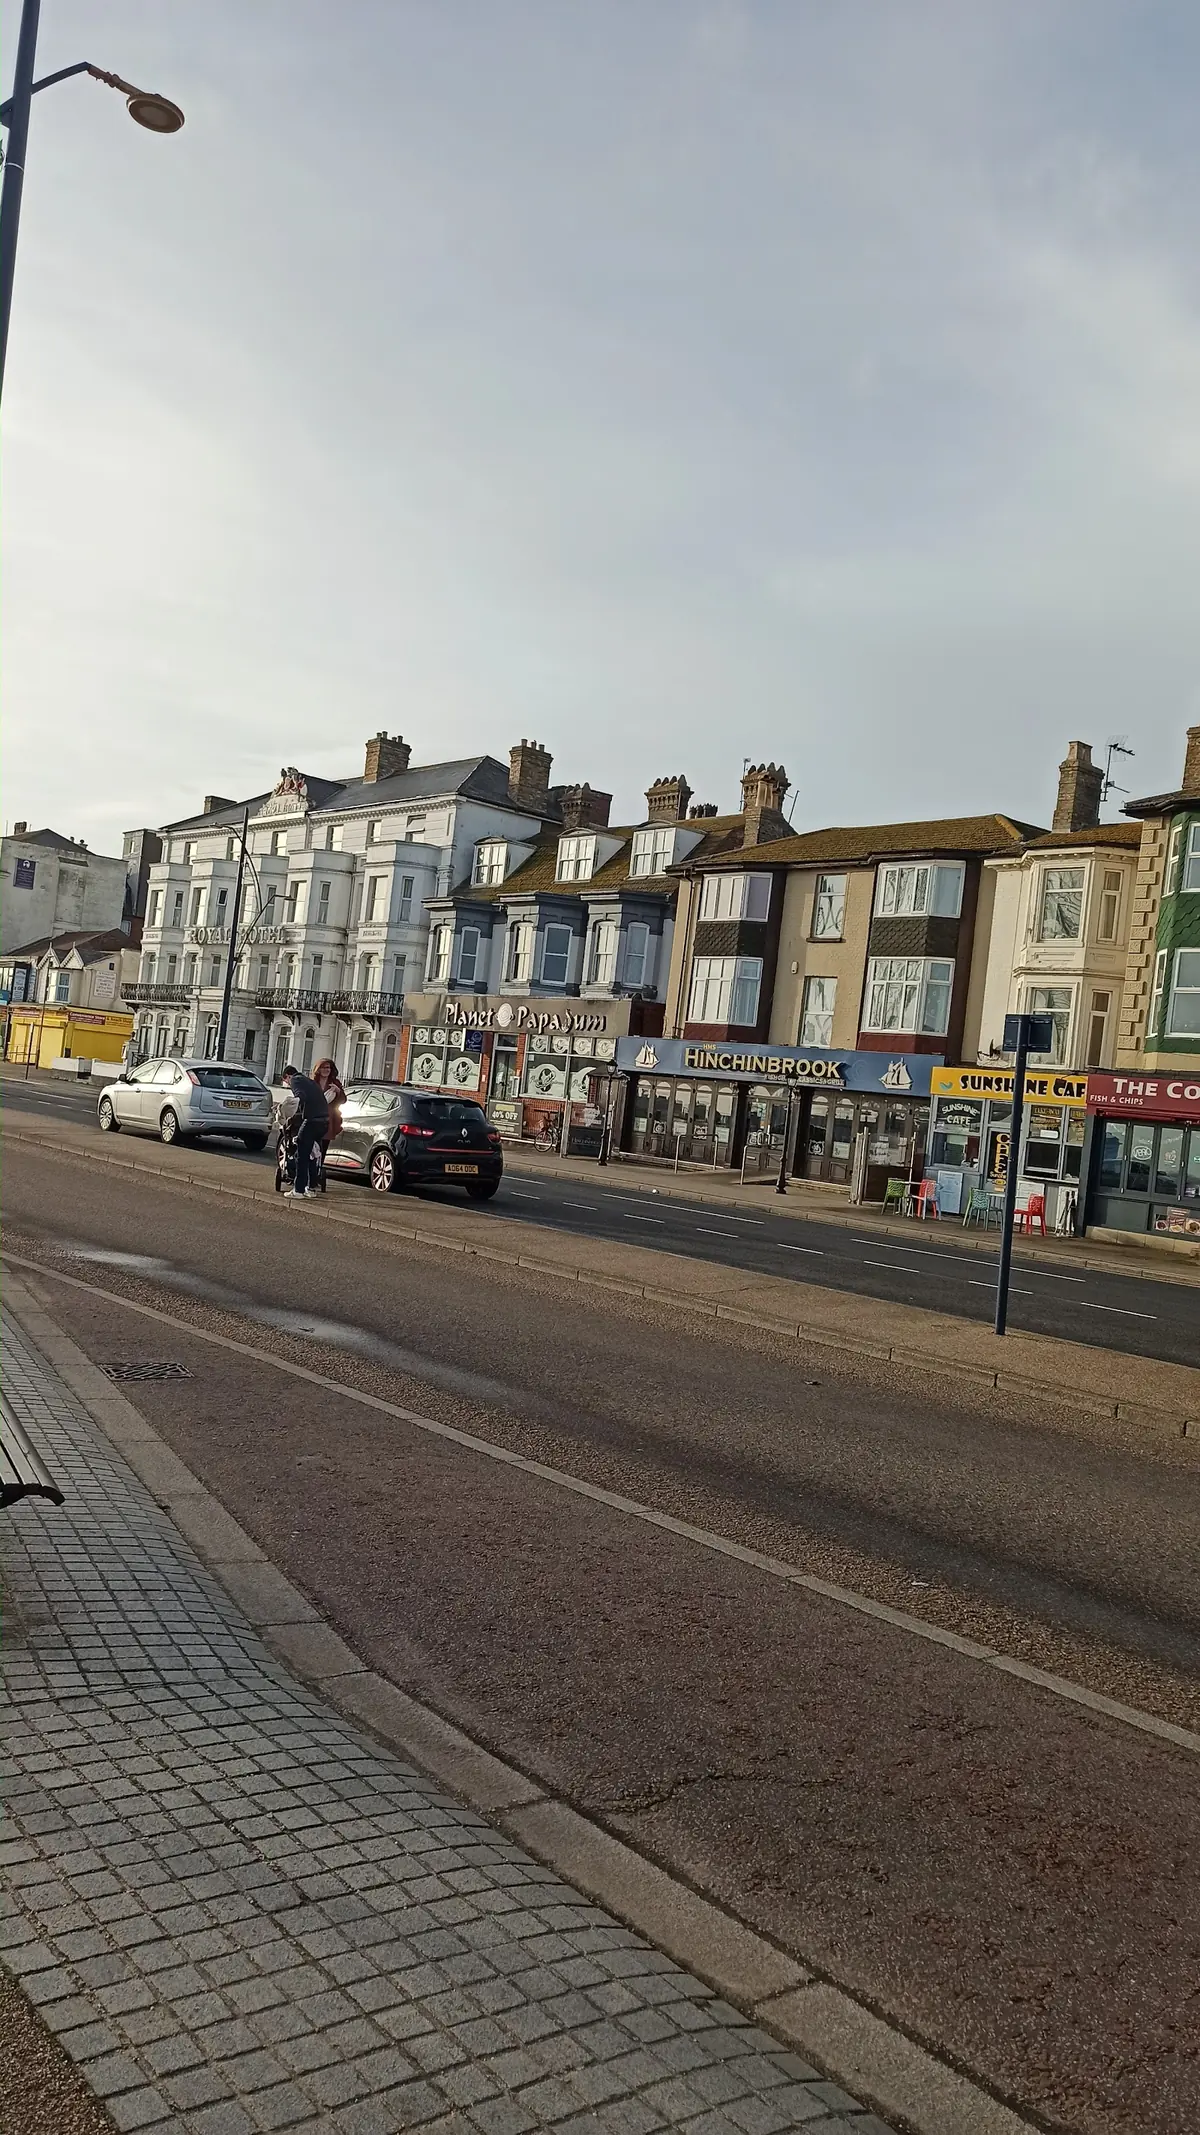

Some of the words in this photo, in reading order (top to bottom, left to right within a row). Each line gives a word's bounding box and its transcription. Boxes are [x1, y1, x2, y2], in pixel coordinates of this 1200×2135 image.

[188, 926, 231, 944] ROYAL
[444, 1002, 495, 1027] Planet
[516, 1005, 607, 1035] Papadum
[702, 1043, 717, 1051] HMS
[684, 1047, 843, 1078] HINCHINBROOK
[960, 1075, 1048, 1096] SUNSHNE
[1113, 1077, 1159, 1097] THE
[1166, 1082, 1200, 1100] CO
[1089, 1094, 1108, 1103] FISH
[1119, 1096, 1144, 1106] CHIPS
[492, 1110, 505, 1119] 40%
[505, 1111, 518, 1121] OFF
[941, 1103, 980, 1116] SUNSHINE
[946, 1114, 971, 1125] CAFE
